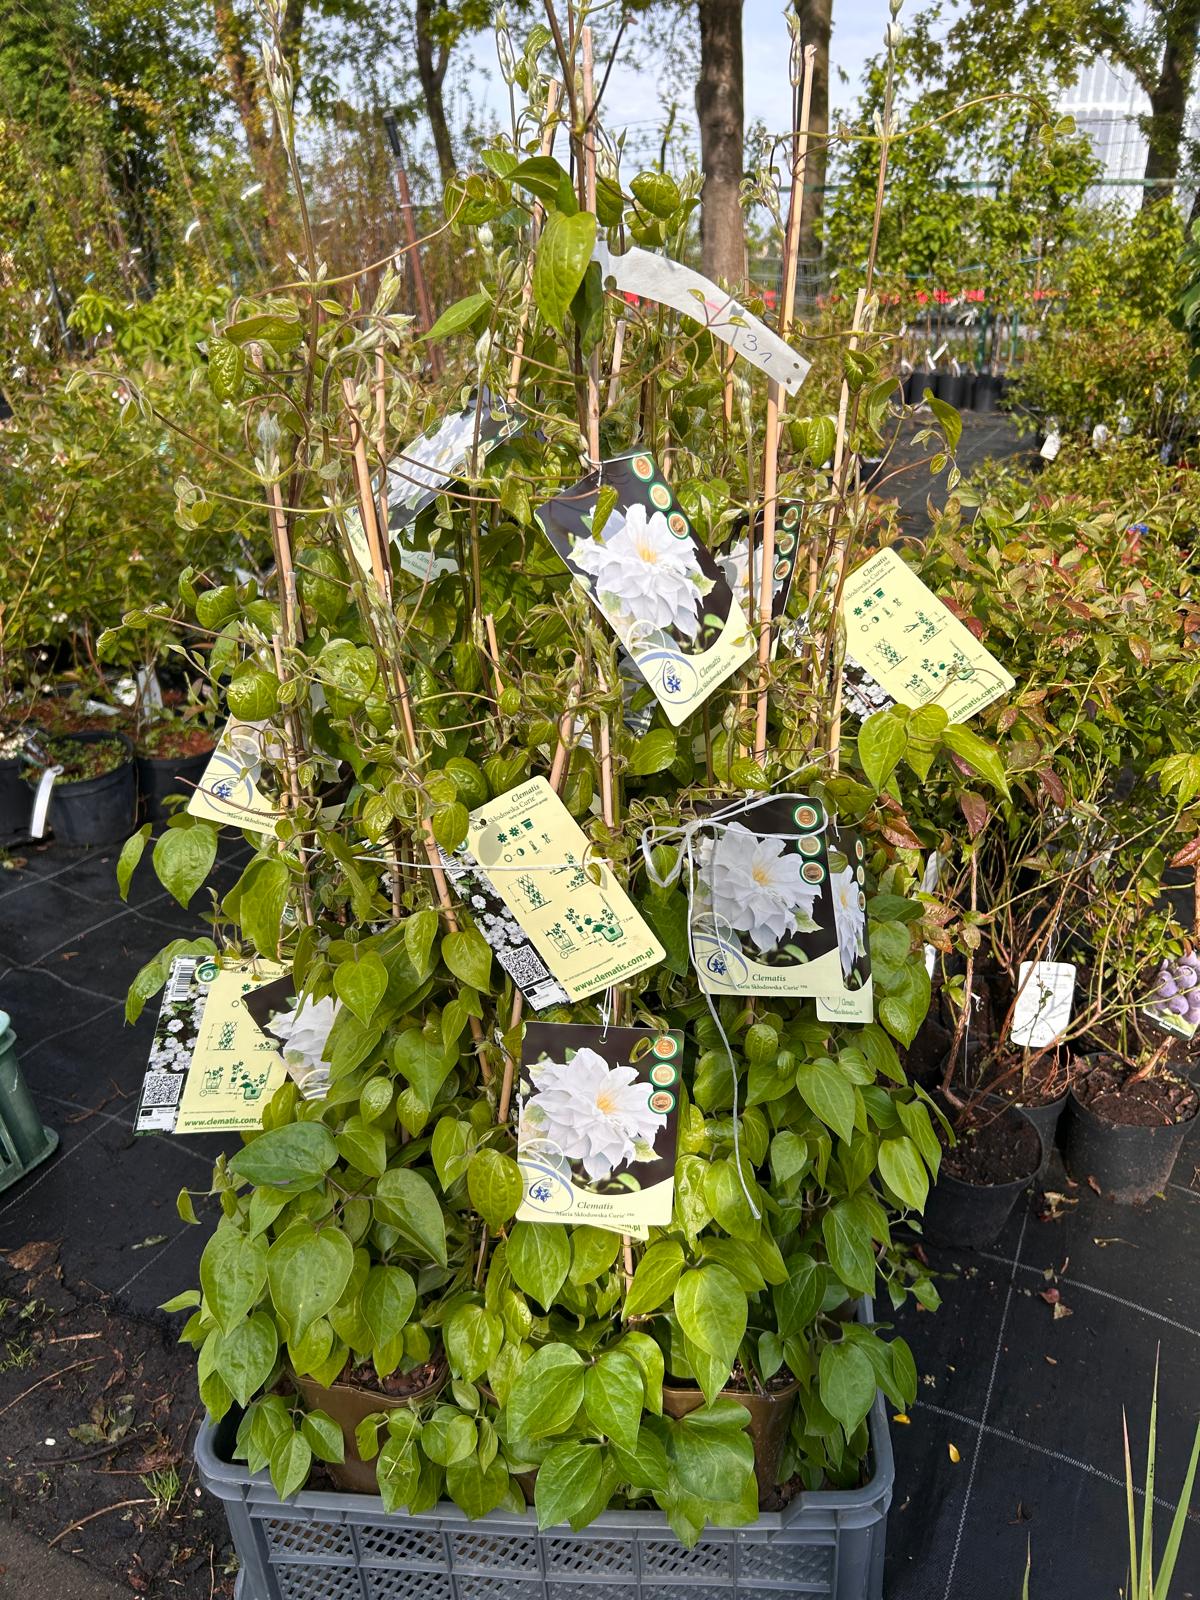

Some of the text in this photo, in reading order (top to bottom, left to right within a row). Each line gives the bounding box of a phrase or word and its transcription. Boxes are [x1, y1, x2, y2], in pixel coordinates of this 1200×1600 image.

[863, 556, 888, 577] Clematis
[511, 784, 541, 803] Clematis
[573, 947, 656, 993] www.clematis.com.pl
[752, 974, 787, 982] Clematis
[184, 1116, 264, 1127] www.clematis.com.p
[577, 1201, 615, 1211] Clematis
[574, 1211, 608, 1219] Skłodowska
